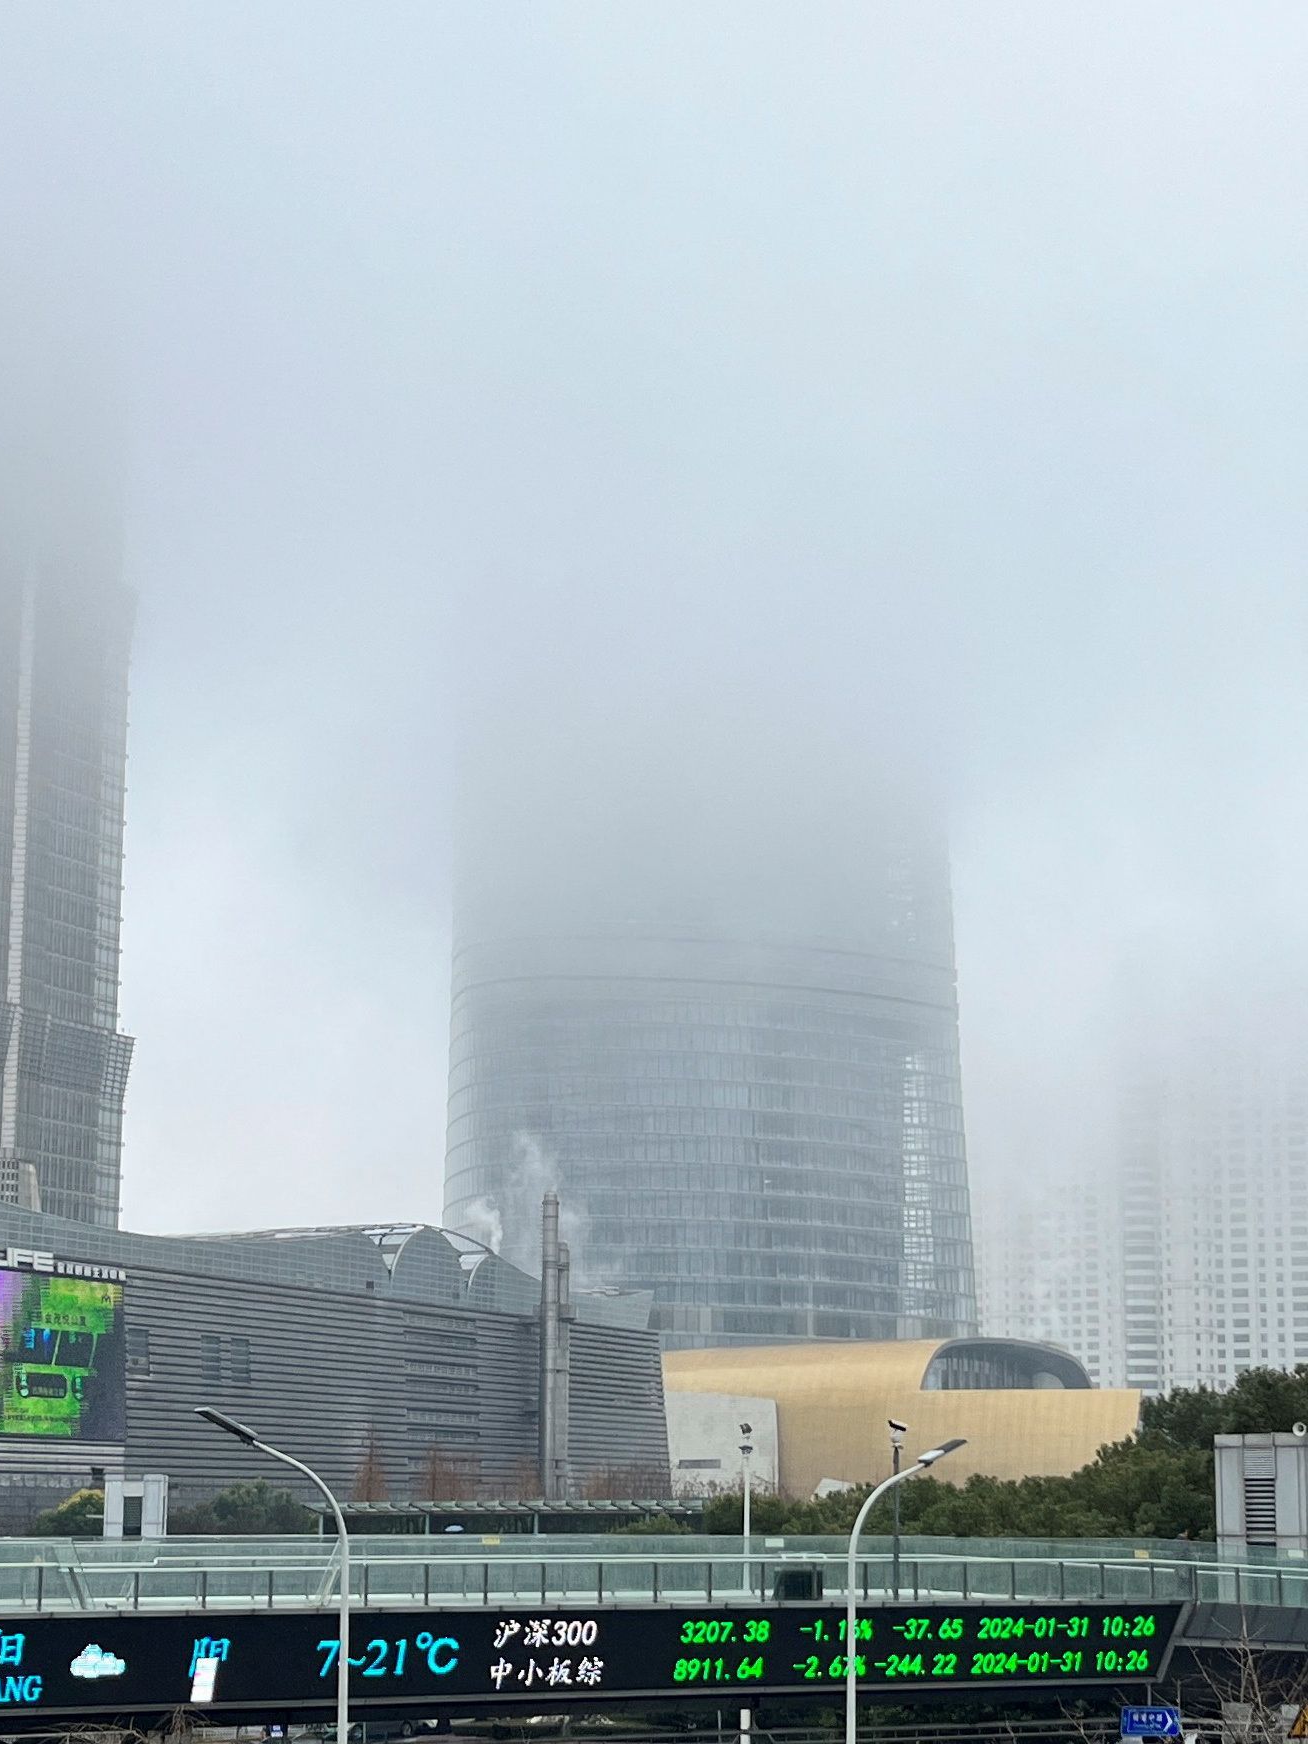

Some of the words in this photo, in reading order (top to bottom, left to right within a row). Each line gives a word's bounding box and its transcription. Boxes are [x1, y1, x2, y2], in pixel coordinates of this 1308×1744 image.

[493, 1619, 598, 1648] 沪深300
[680, 1620, 770, 1644] 3207.38
[892, 1617, 964, 1640] -37.65
[977, 1616, 1089, 1639] 2024-01-31
[1102, 1615, 1155, 1637] 10:26
[490, 1656, 604, 1690] 中小板综
[673, 1656, 764, 1682] 8911.64
[874, 1653, 957, 1677] -244.22
[970, 1651, 1082, 1675] 2024-01-31
[1095, 1649, 1149, 1672] 10:26
